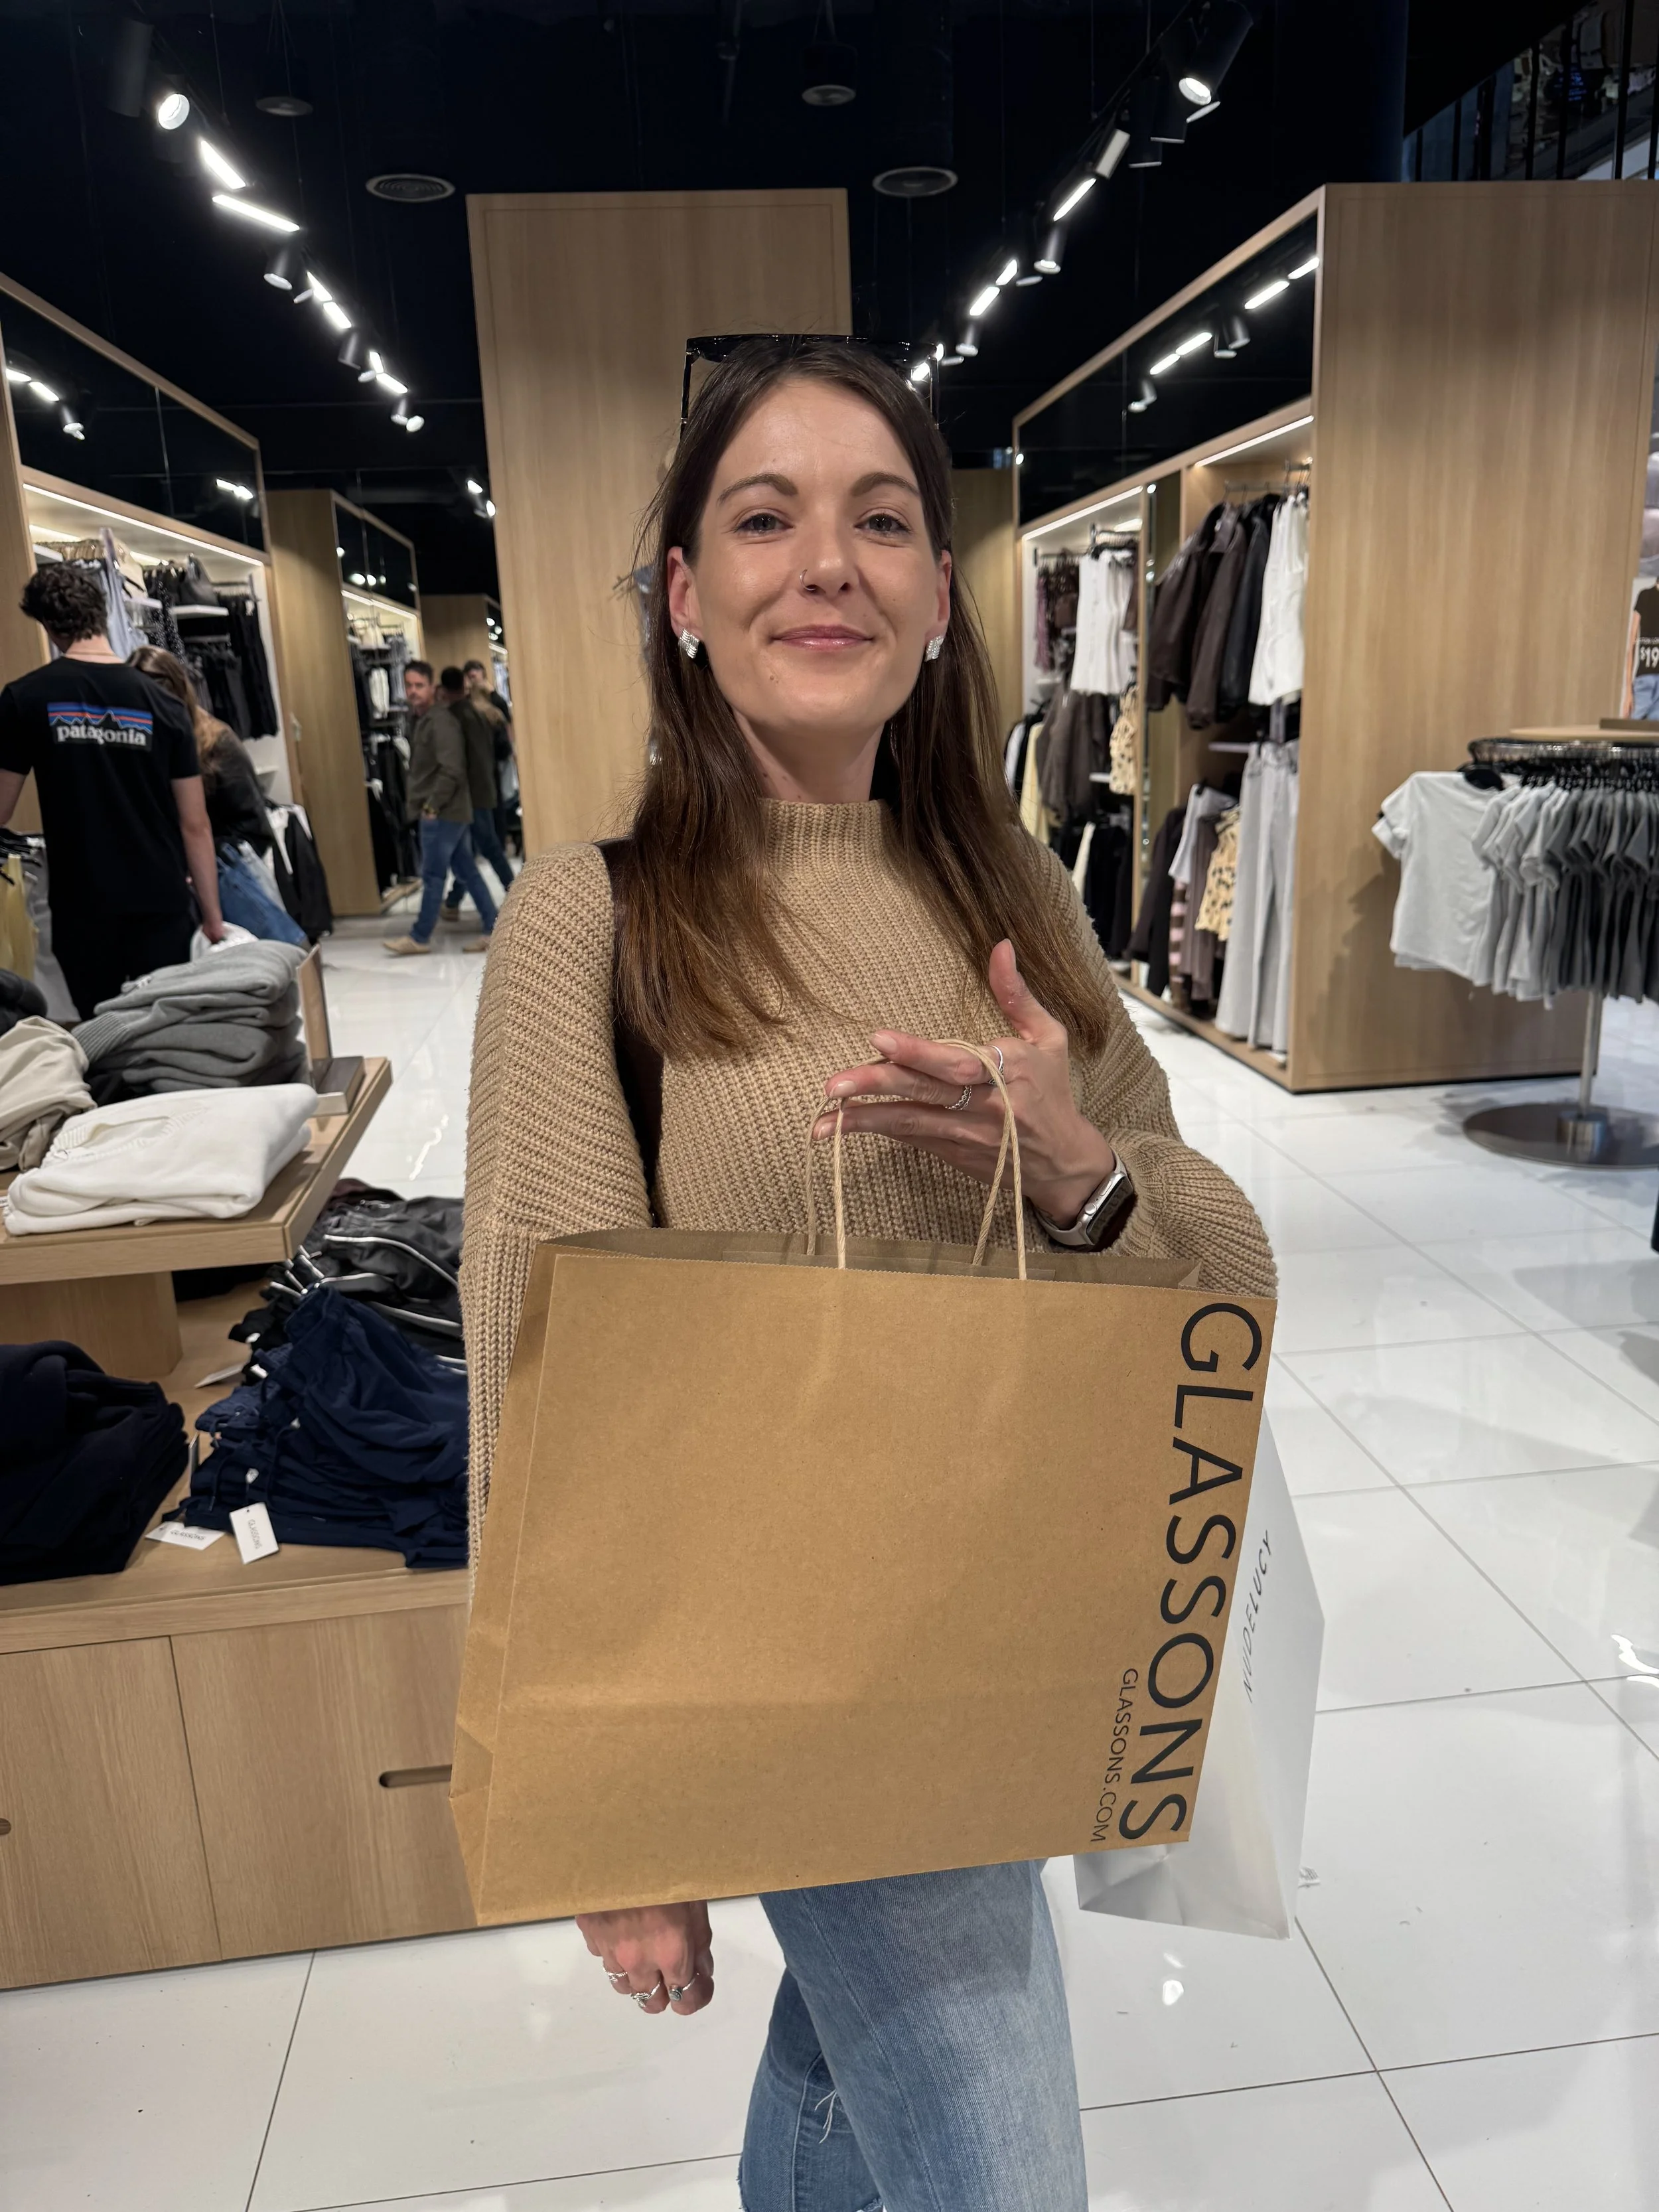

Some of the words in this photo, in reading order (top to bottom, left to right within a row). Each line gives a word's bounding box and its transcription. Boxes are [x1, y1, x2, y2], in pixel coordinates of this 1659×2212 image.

[57, 725, 147, 745] patagonia
[1119, 1303, 1262, 1840] GLASSONS
[1243, 1530, 1271, 1704] NUDELUCY
[1090, 1668, 1139, 1842] GLASSONS.COM
